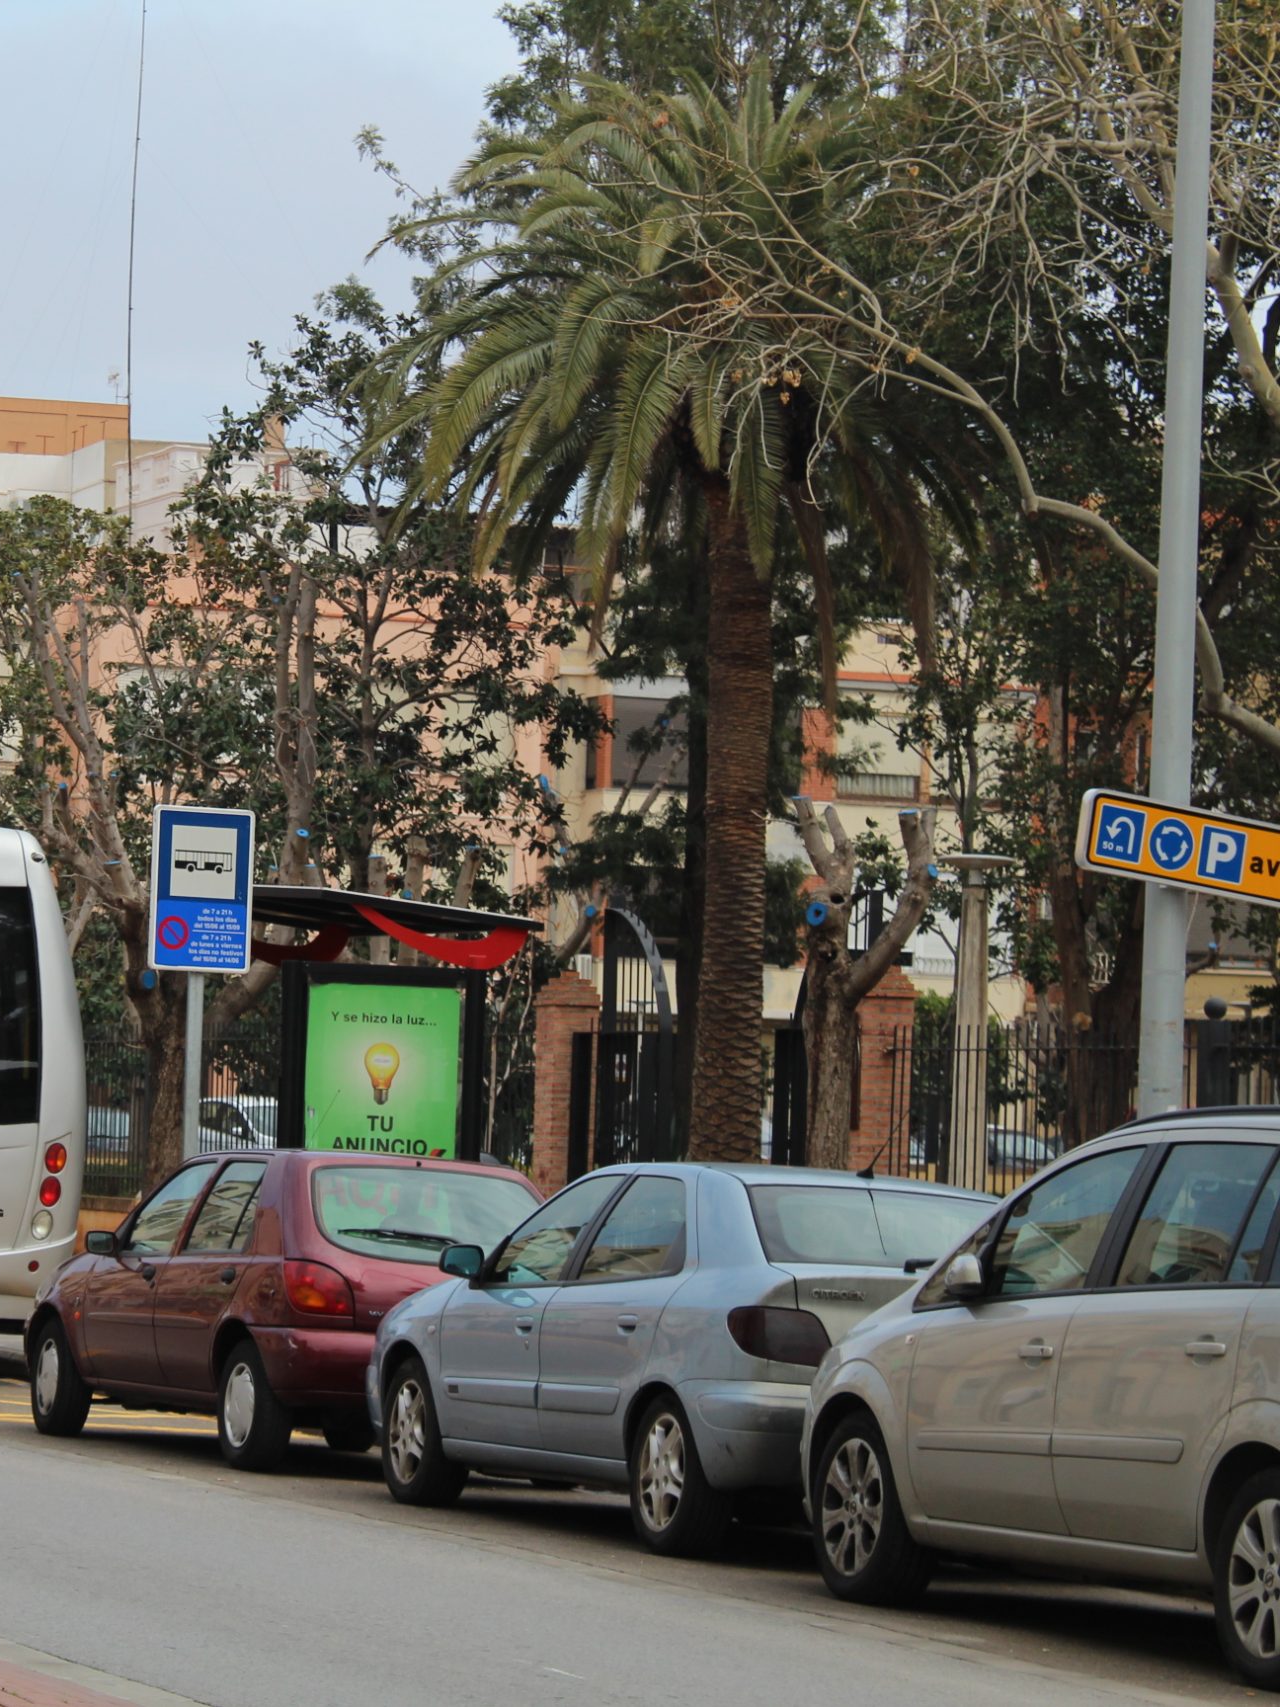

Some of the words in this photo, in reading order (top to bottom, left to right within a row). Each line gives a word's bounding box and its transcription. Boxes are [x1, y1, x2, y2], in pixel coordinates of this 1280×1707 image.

[1102, 840, 1114, 850] 50
[1205, 831, 1237, 874] P
[221, 942, 242, 950] viernes
[331, 1011, 340, 1022] Y
[343, 1014, 358, 1023] se
[362, 1012, 388, 1025] hizo
[392, 1013, 403, 1025] la
[367, 1115, 394, 1133] TU
